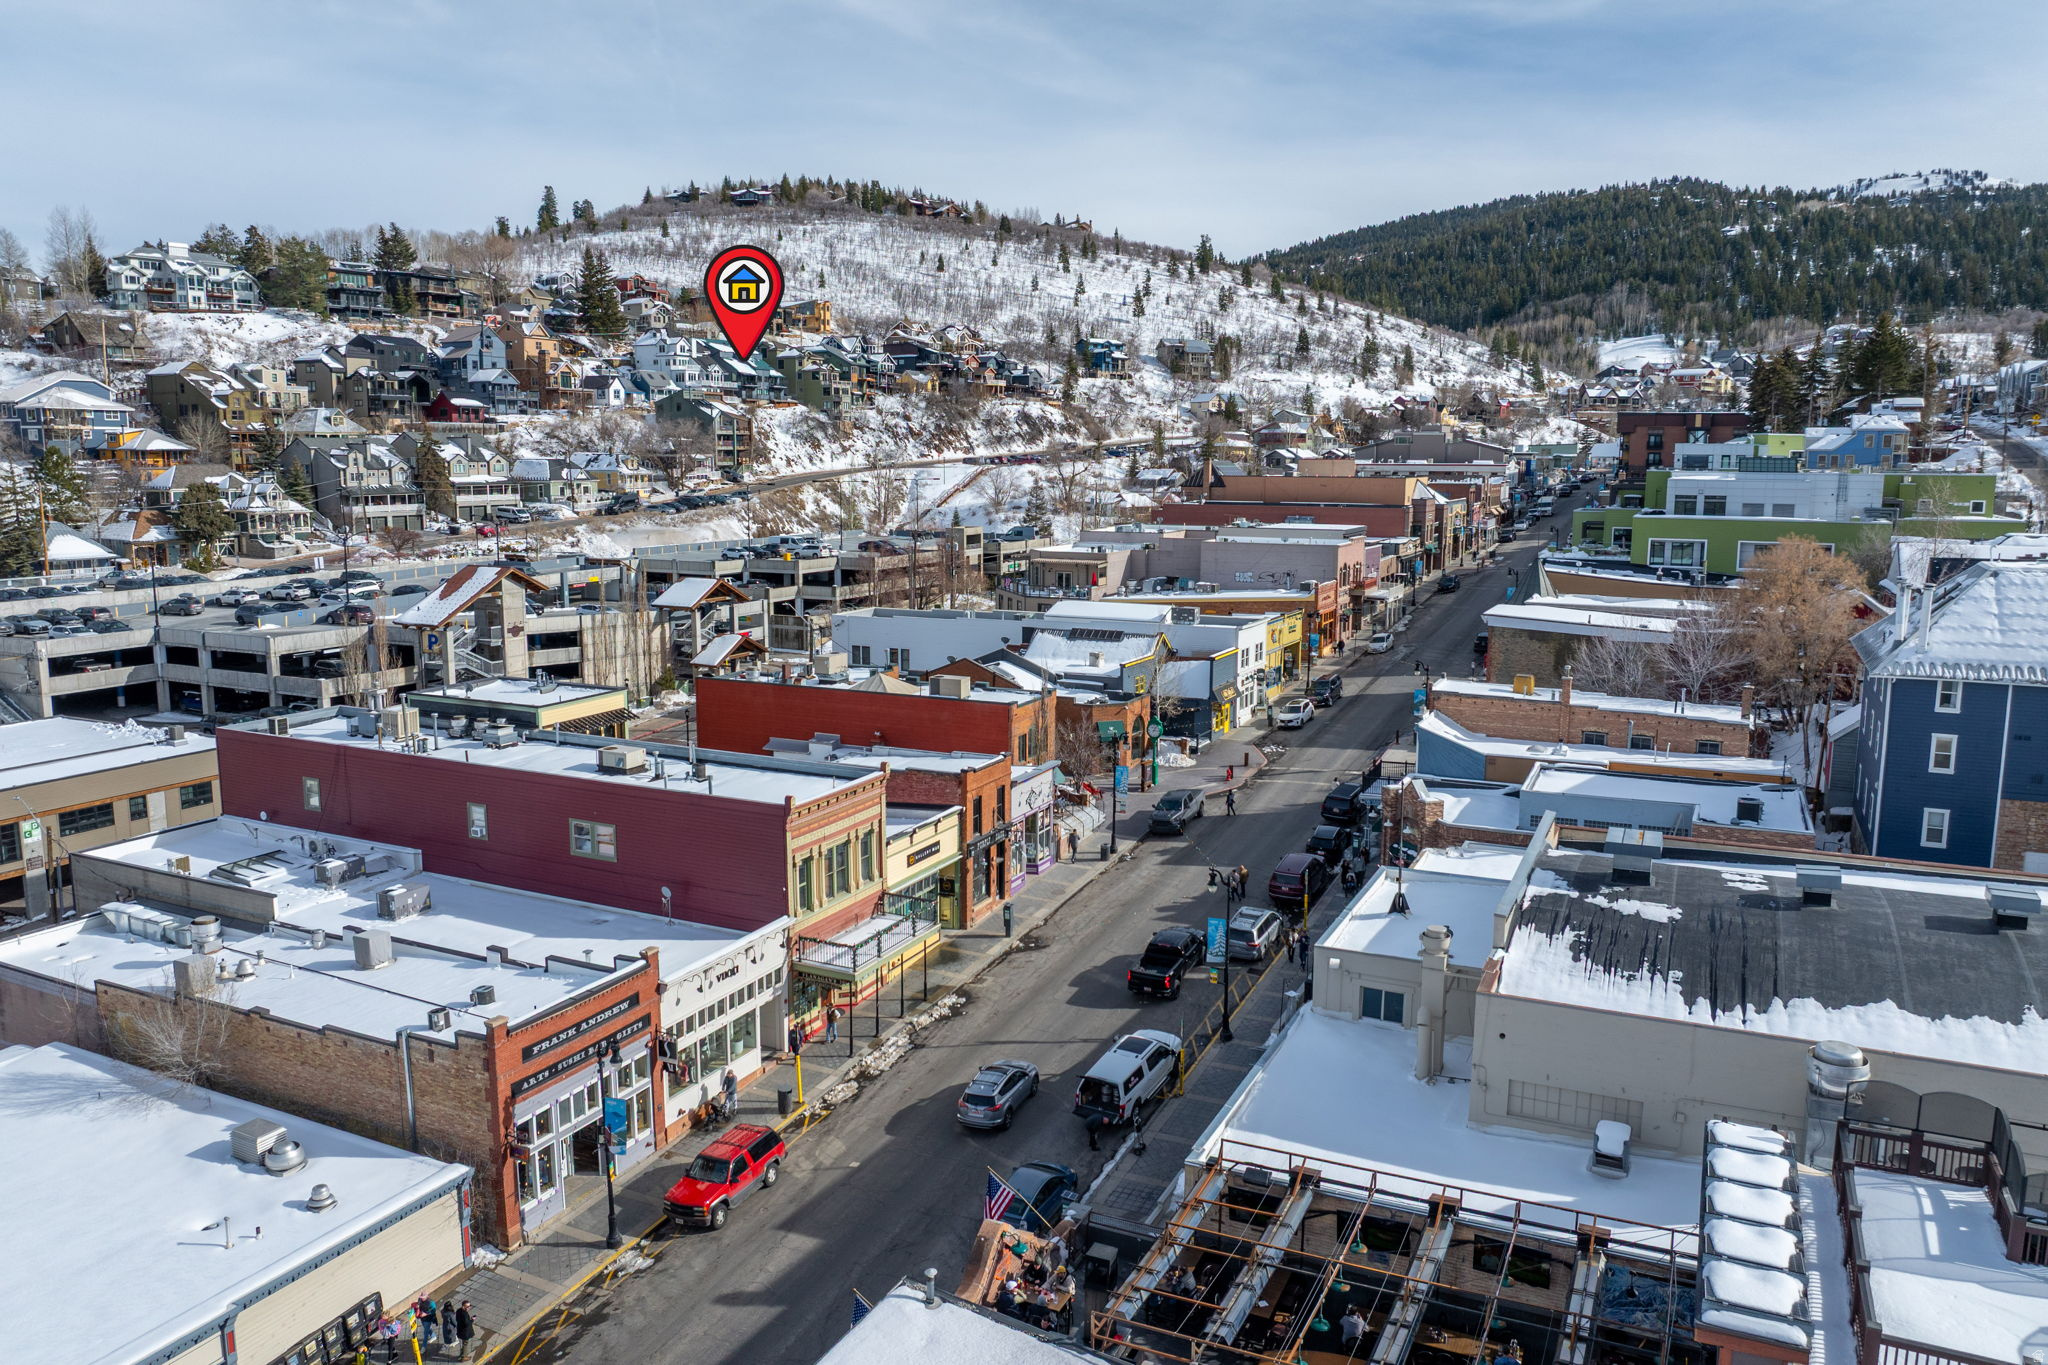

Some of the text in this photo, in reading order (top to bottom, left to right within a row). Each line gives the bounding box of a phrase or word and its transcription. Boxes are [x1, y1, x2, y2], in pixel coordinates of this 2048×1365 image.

[428, 633, 439, 651] P
[521, 1068, 549, 1090] ARTS
[557, 1049, 585, 1071] SUSHI
[616, 1020, 643, 1040] GIFTS
[532, 1000, 630, 1055] FRANK ANDREW
